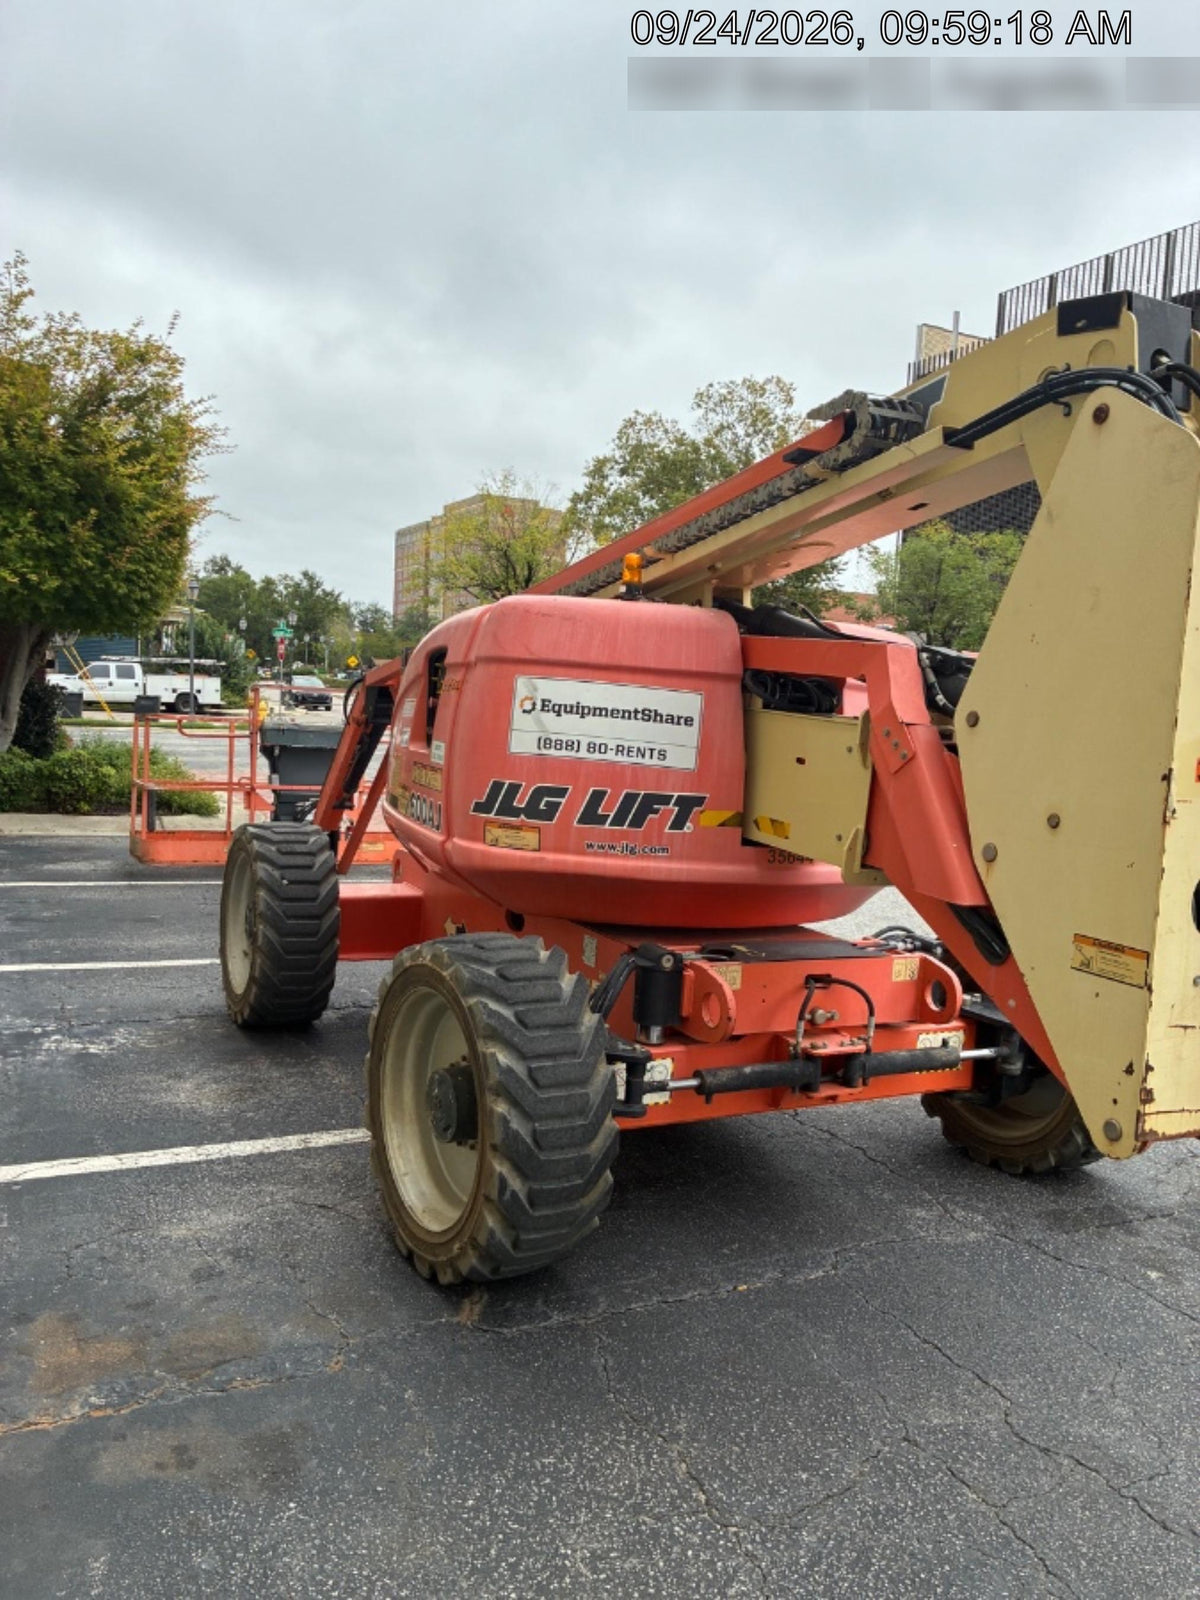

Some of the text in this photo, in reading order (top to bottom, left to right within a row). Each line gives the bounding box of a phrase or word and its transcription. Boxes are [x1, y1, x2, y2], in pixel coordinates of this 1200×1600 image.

[540, 698, 695, 728] EquipmentShare
[536, 736, 668, 762] (888) 80-RENTS
[470, 779, 709, 832] JLG LIFT
[585, 841, 670, 856] www.jlg.com
